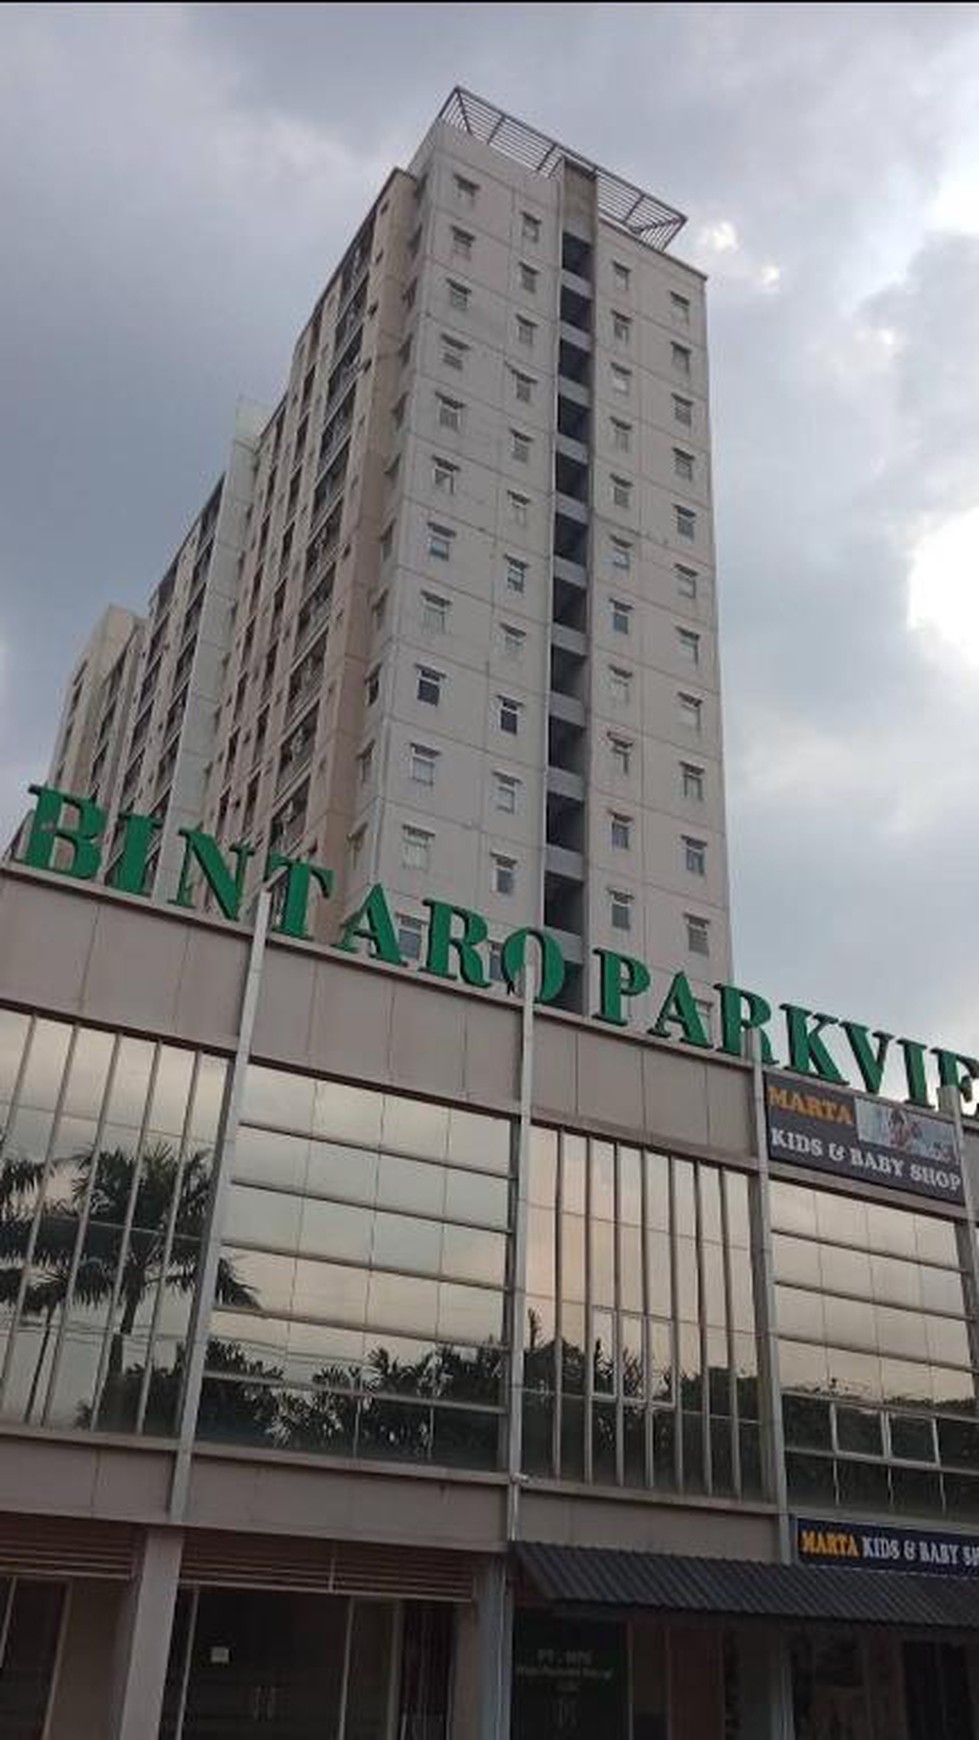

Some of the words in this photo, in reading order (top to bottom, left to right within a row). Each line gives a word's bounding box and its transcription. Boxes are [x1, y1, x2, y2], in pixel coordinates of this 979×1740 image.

[23, 783, 566, 1004] BINTARO
[768, 1087, 854, 1125] MARTA
[771, 1127, 823, 1157] KIDS
[828, 1142, 846, 1162] &
[850, 1147, 904, 1177] BABY
[910, 1164, 962, 1191] SHOP
[801, 1530, 860, 1558] MARTA
[862, 1537, 900, 1560] KIDS
[904, 1540, 917, 1561] &
[919, 1542, 959, 1565] BABY
